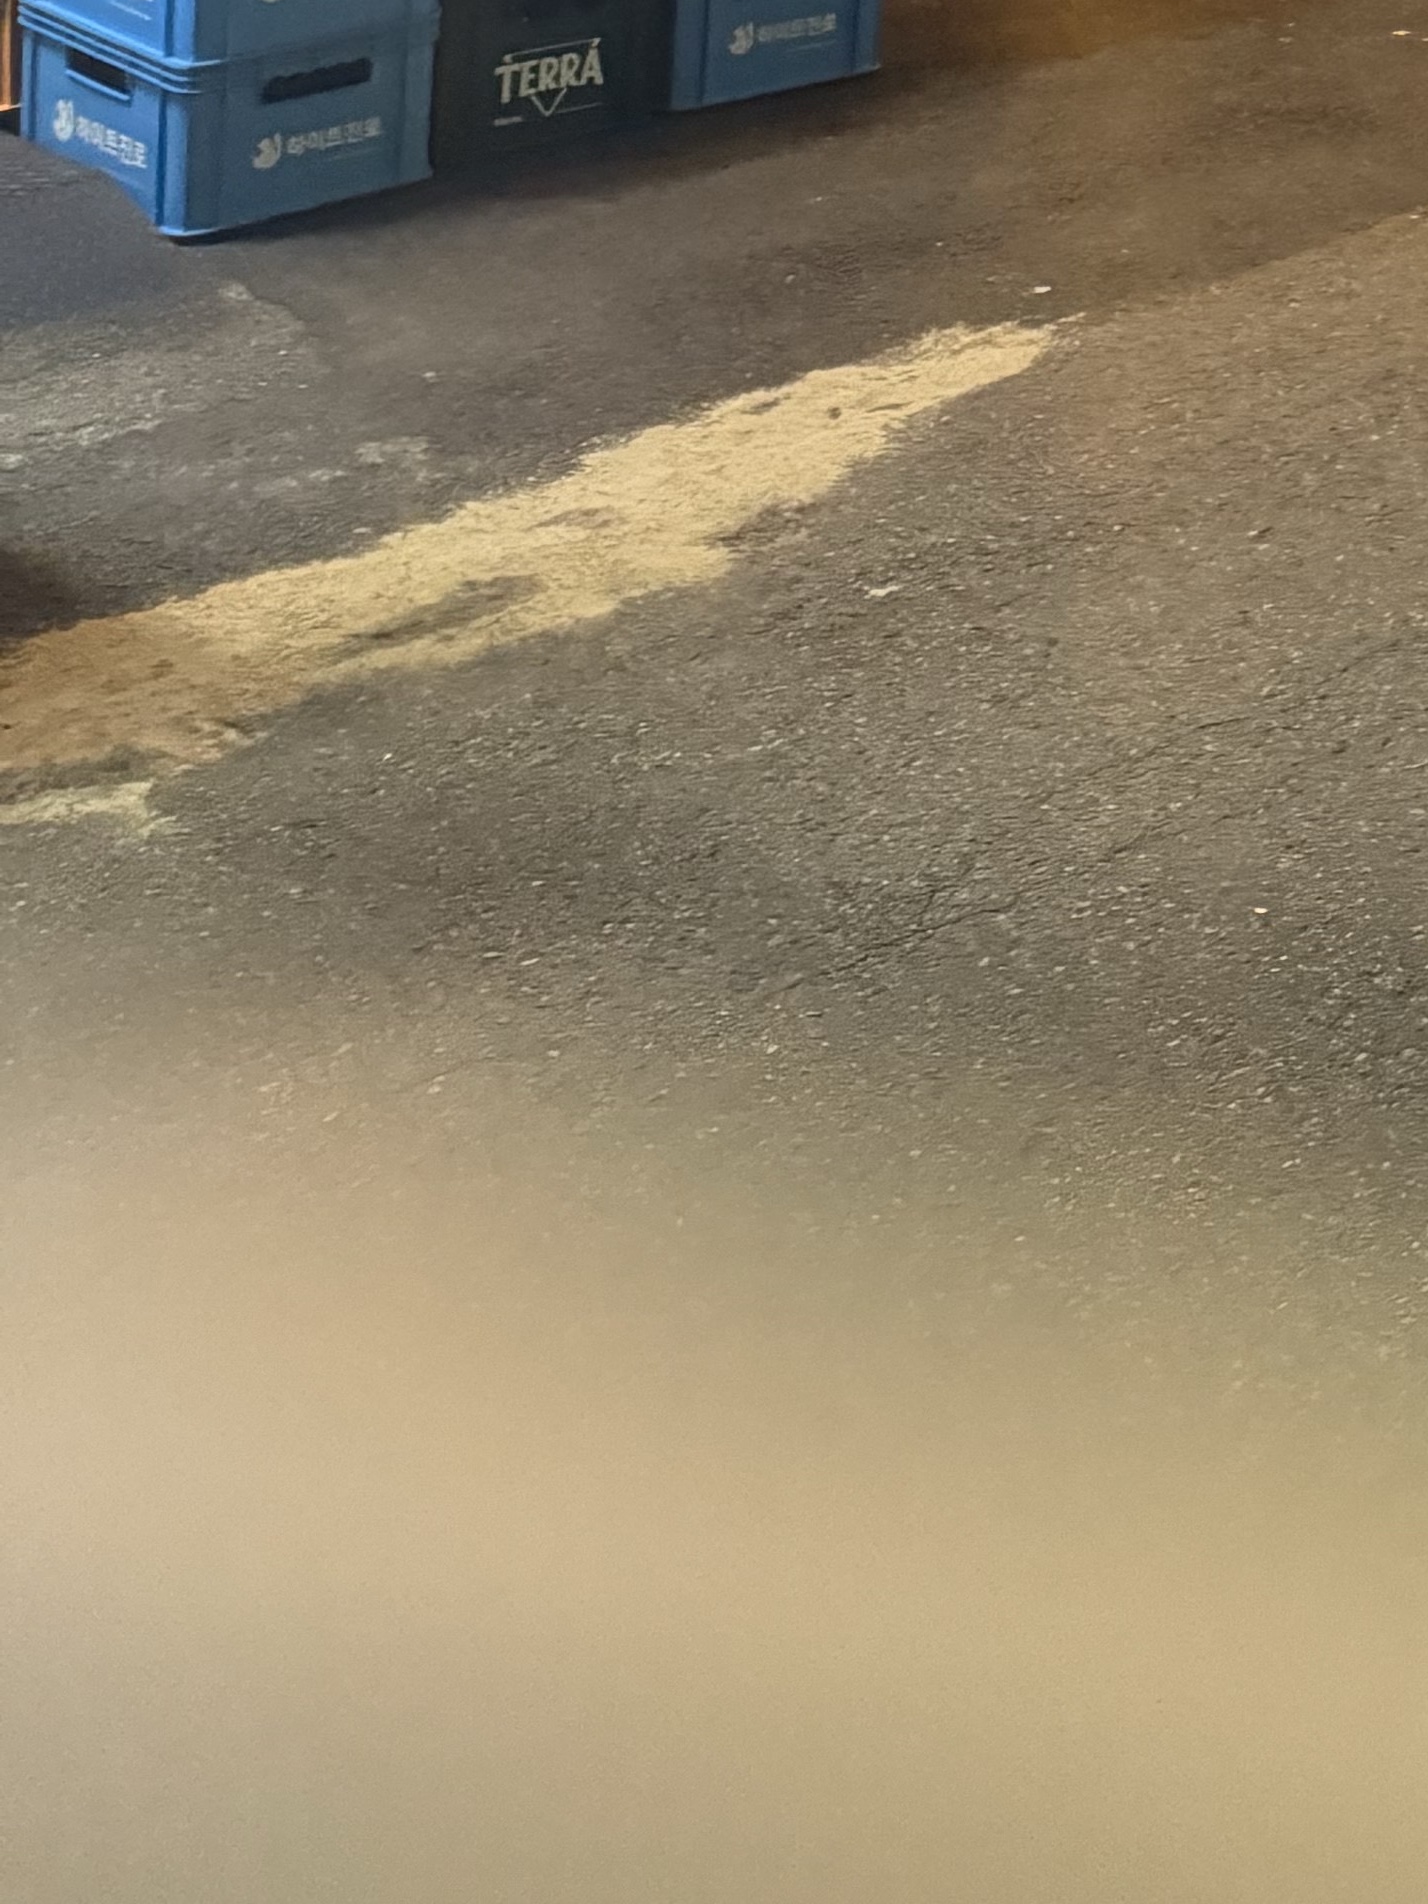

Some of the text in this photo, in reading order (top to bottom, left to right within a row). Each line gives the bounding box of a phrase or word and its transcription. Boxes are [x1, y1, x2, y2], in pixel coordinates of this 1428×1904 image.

[494, 49, 604, 104] TERRA
[76, 117, 148, 169] 하이트진로
[285, 116, 382, 155] 하이트진로
